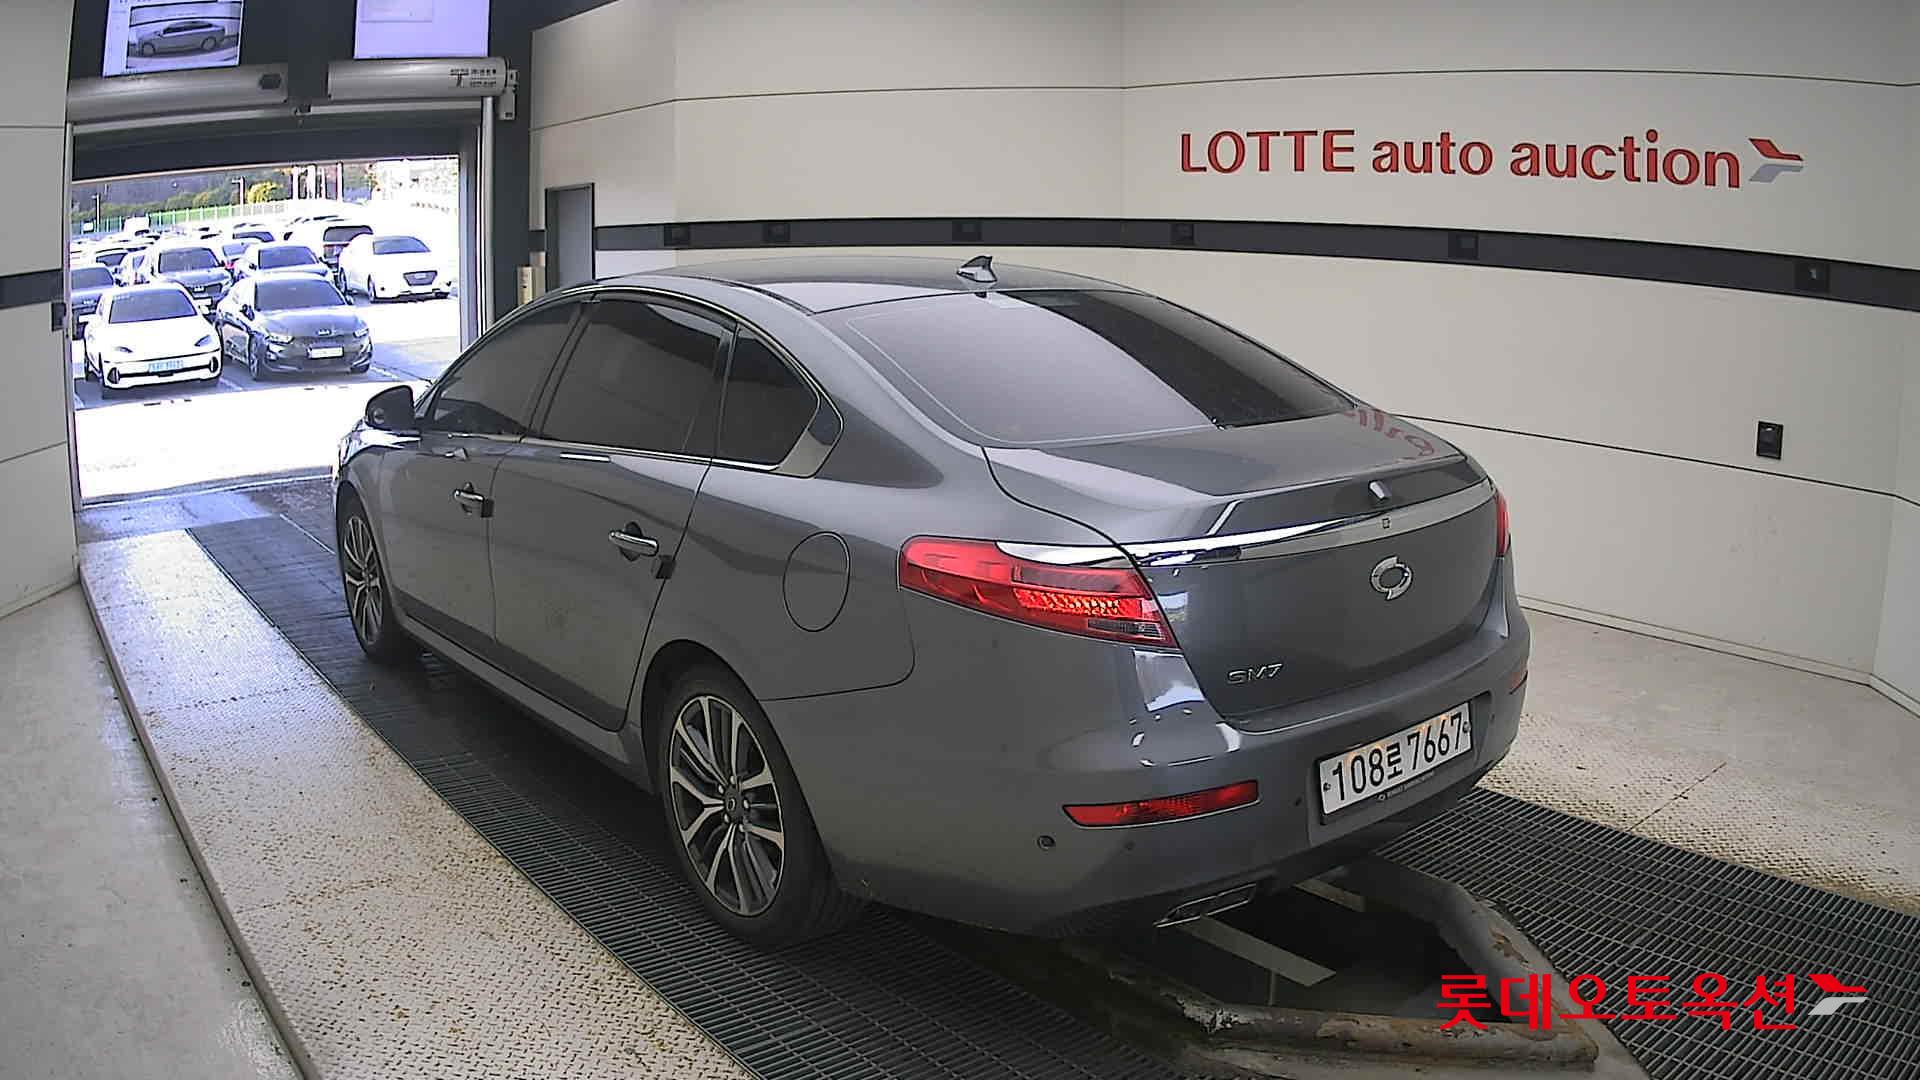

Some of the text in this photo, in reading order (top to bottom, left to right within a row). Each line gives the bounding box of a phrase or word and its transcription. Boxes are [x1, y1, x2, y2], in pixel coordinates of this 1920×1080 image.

[1181, 128, 1742, 190] LOTTE auto auction
[1227, 662, 1283, 685] SM7
